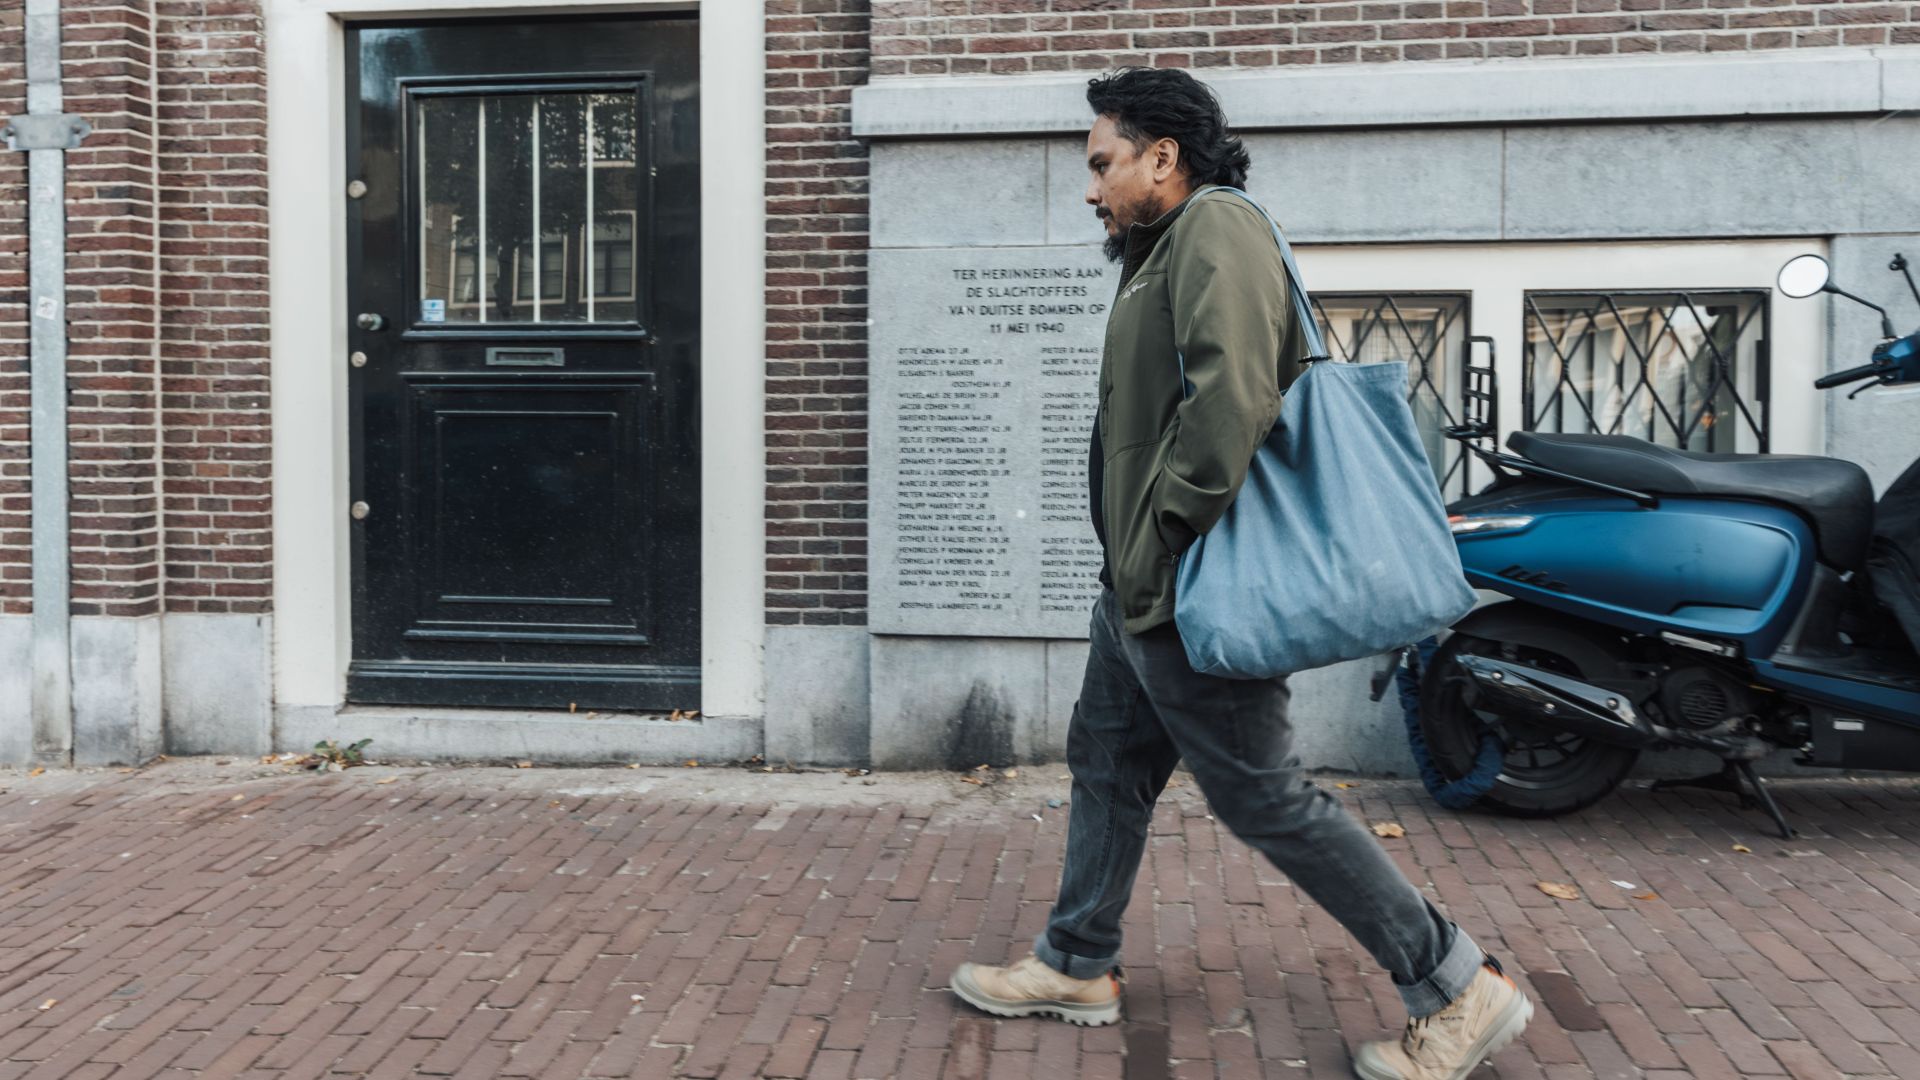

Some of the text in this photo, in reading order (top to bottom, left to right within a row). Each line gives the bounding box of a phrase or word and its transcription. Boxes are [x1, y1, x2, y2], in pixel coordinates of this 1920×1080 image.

[952, 268, 1103, 280] TER HERINNERING AAN
[966, 286, 1088, 298] DE SLACHTOFFERS
[949, 304, 1106, 316] VAN DUITSE BOMMEN OP
[990, 323, 1064, 333] 11 MEI 1940
